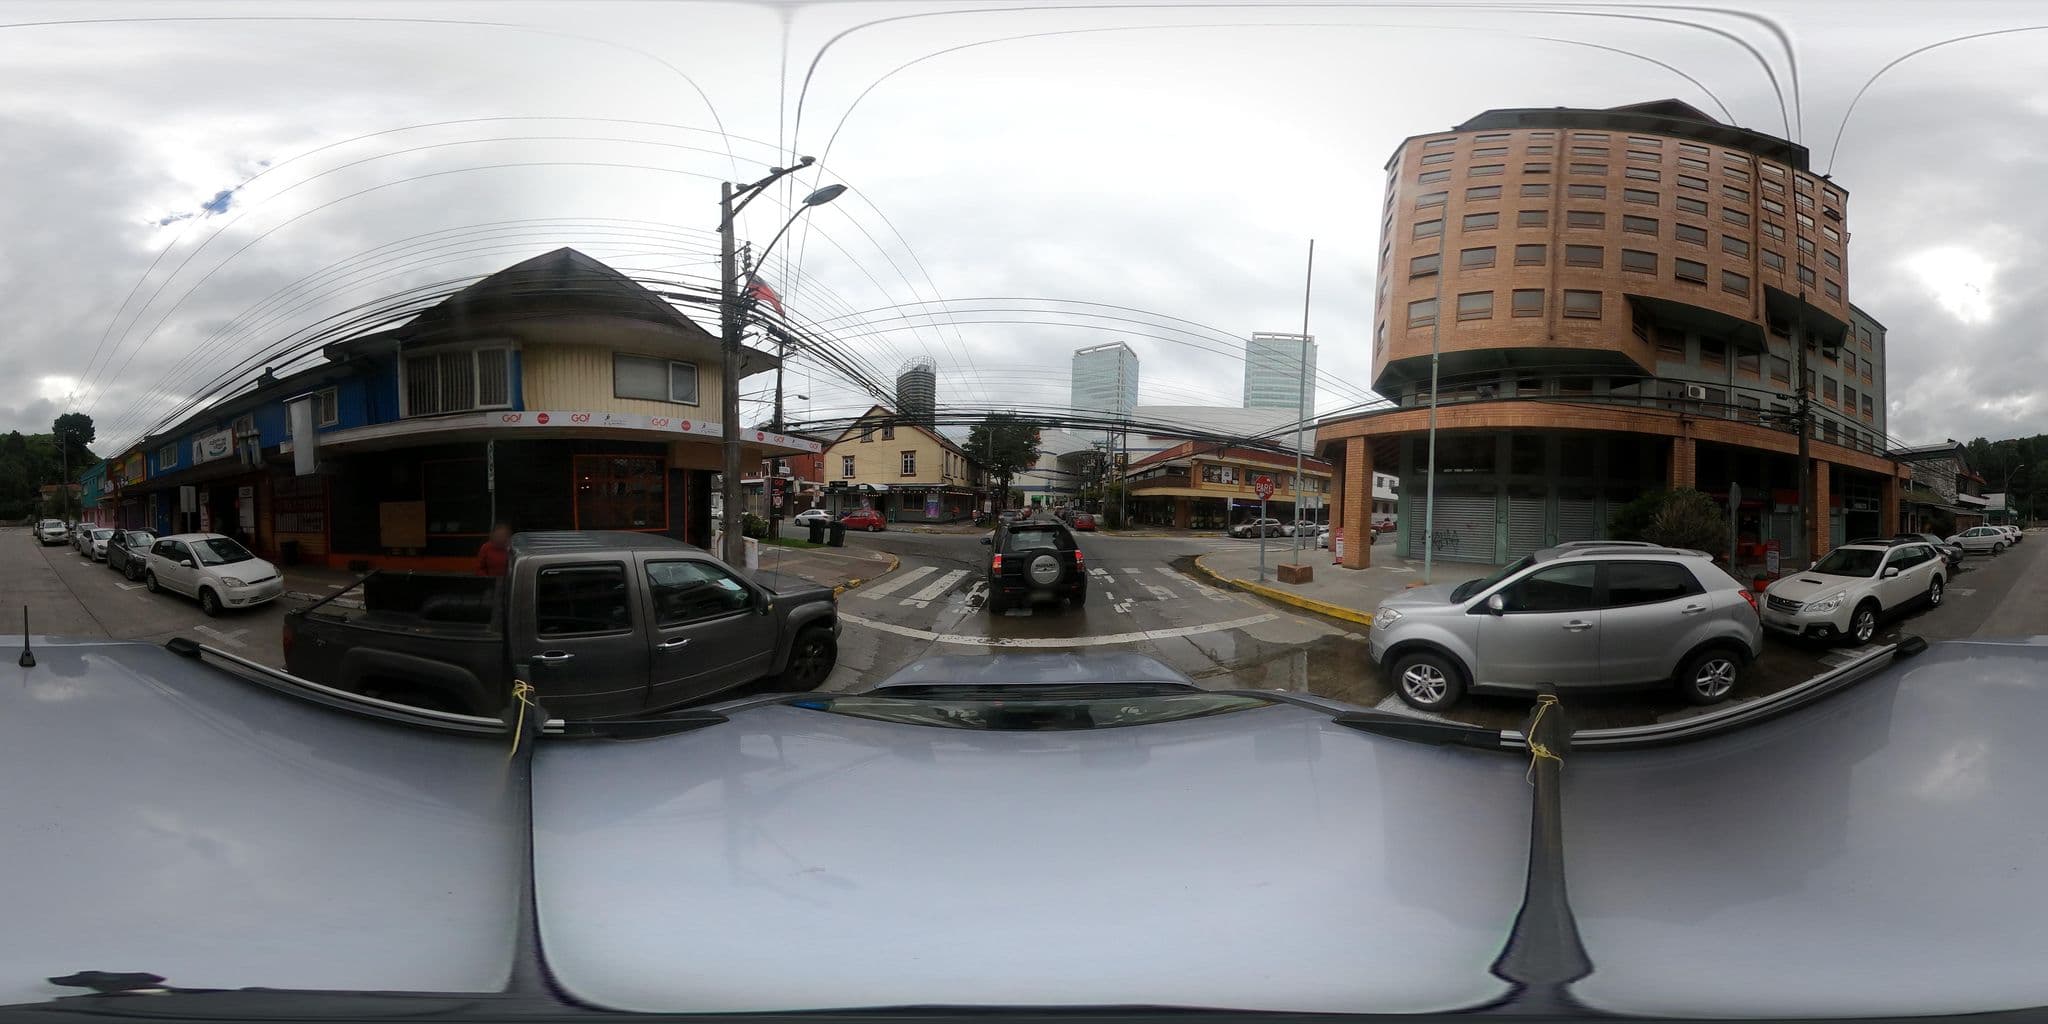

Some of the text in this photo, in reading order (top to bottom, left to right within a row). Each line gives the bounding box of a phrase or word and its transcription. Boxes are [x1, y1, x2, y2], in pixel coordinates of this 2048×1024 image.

[502, 413, 522, 424] GO!
[571, 413, 591, 424] GO!
[651, 417, 669, 427] GO!
[1256, 483, 1273, 494] PARE
